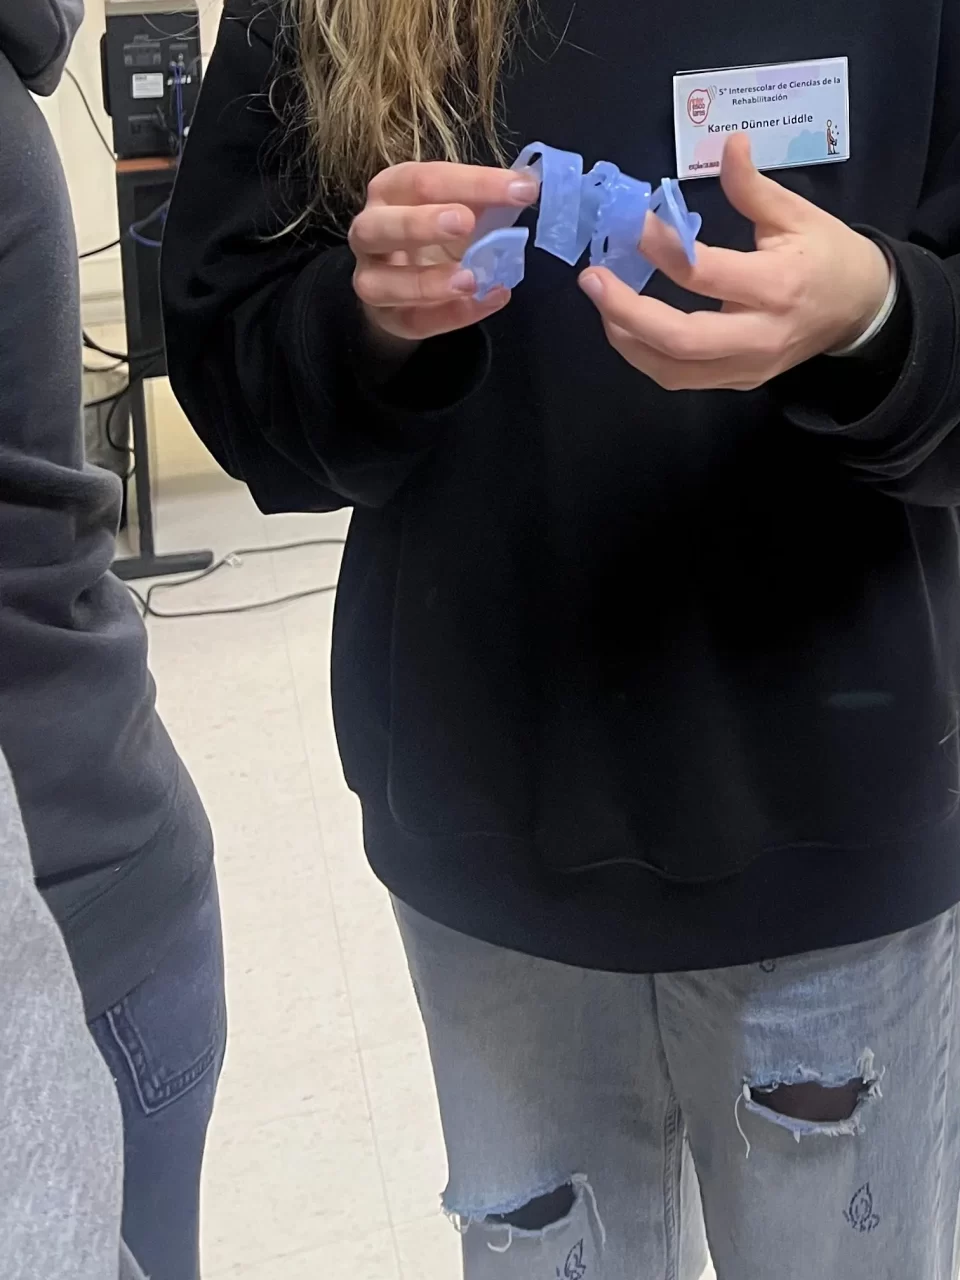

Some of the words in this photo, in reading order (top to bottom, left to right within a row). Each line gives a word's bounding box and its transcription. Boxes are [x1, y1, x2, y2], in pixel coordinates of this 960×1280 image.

[729, 84, 776, 95] Interescolar
[777, 82, 788, 90] de
[789, 80, 821, 89] Ciencias
[822, 77, 832, 85] de
[732, 94, 788, 106] Rehabilitación
[708, 123, 738, 134] Karen
[741, 118, 780, 130] Dünner
[783, 114, 813, 126] Liddle
